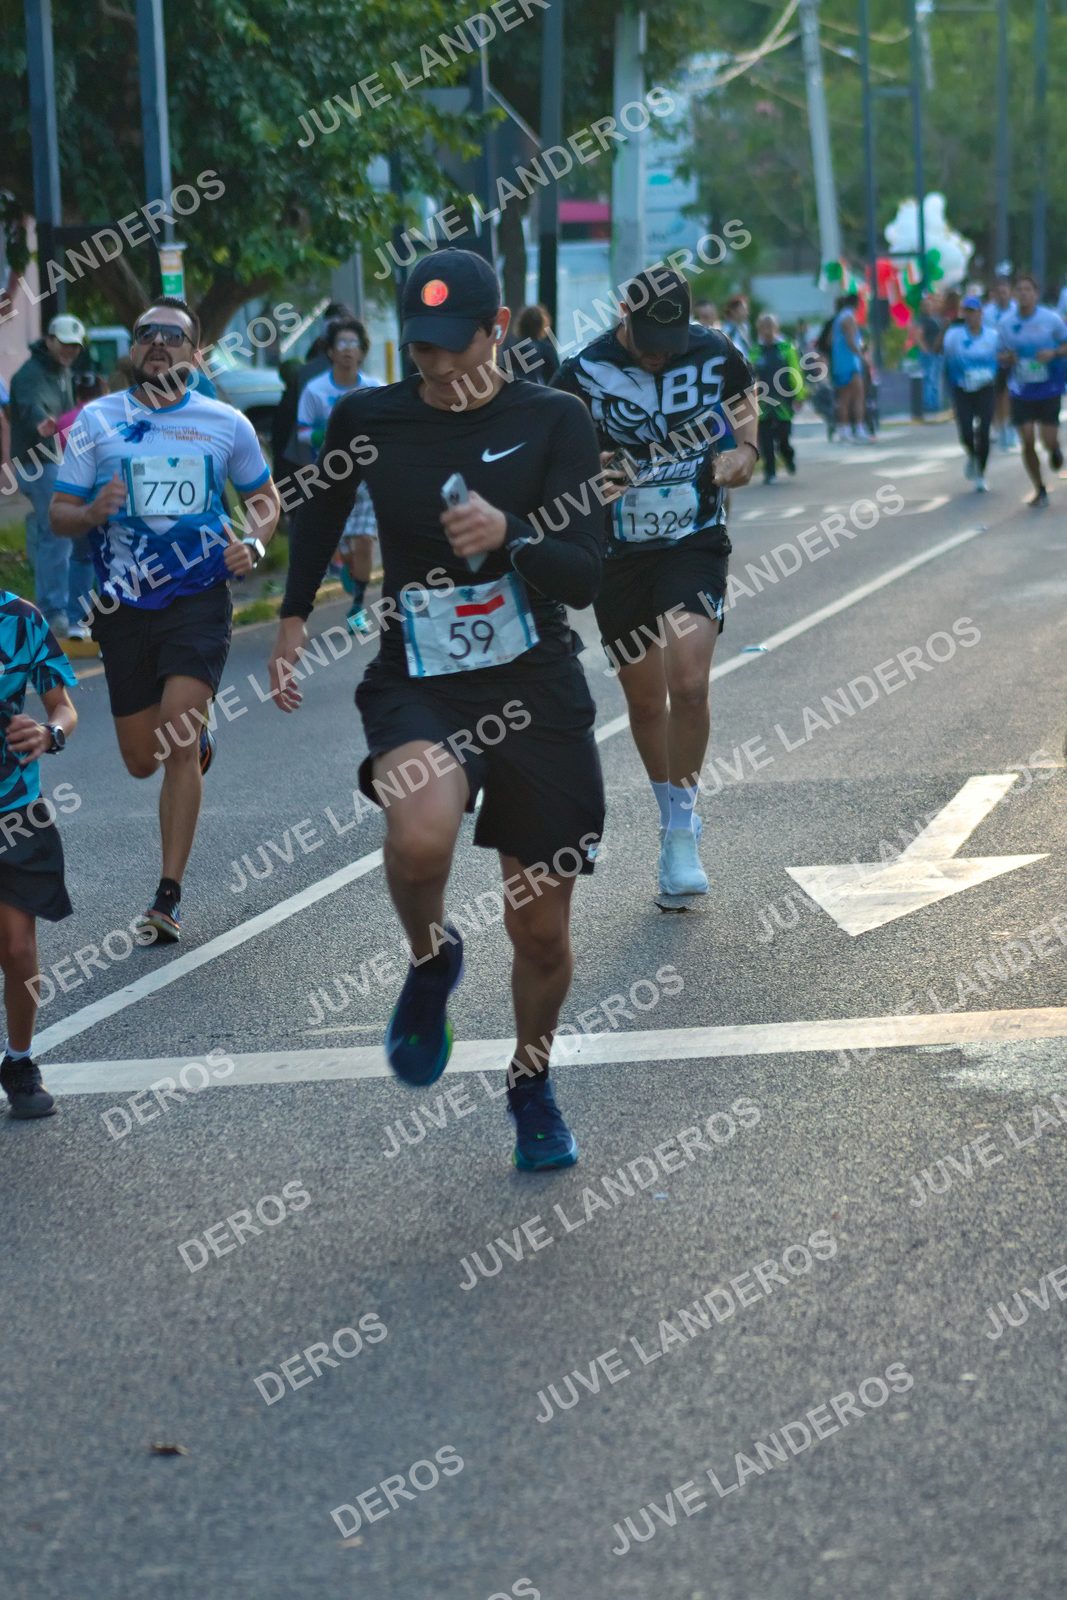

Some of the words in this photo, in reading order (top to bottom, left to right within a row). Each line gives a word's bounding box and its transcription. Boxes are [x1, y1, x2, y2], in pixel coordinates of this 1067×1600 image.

[142, 480, 196, 507] 770
[627, 508, 694, 536] 1326
[448, 620, 495, 660] 59
